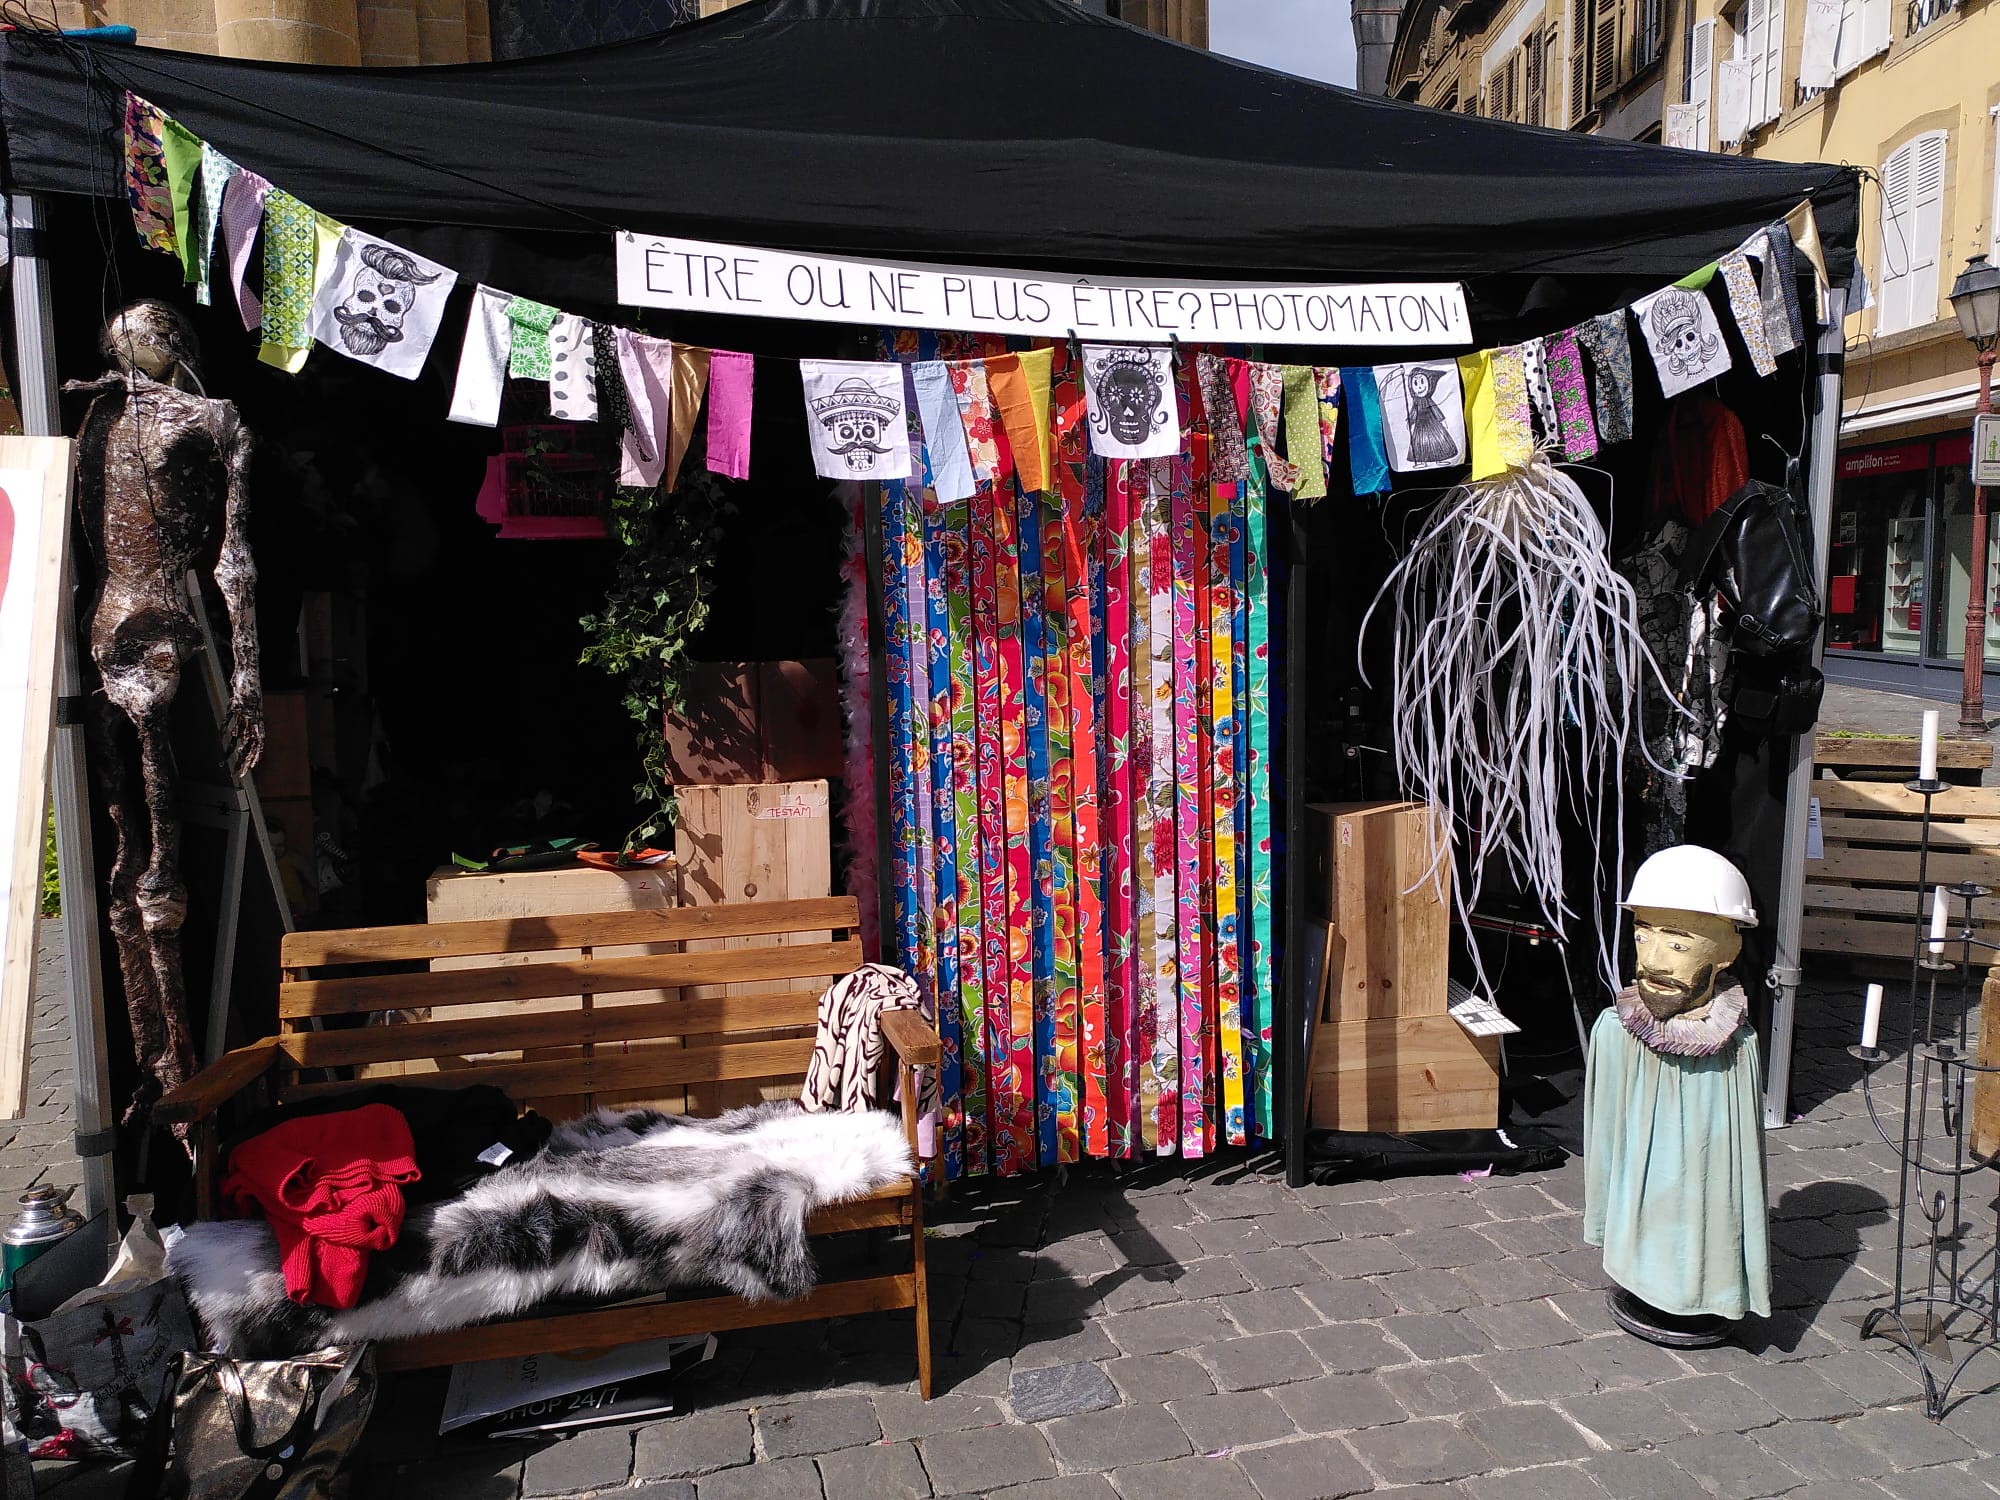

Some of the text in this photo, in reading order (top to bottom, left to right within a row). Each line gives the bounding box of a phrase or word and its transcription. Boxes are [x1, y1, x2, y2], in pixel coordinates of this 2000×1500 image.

[645, 241, 762, 303] ÊTRE
[788, 264, 850, 309] OU
[869, 270, 924, 315] NE
[943, 276, 1051, 323] PLUS
[1072, 277, 1202, 330] ÊTRE?
[1845, 454, 1883, 473] amplifon
[767, 806, 812, 819] TESTAM
[567, 1387, 620, 1409] 24/7
